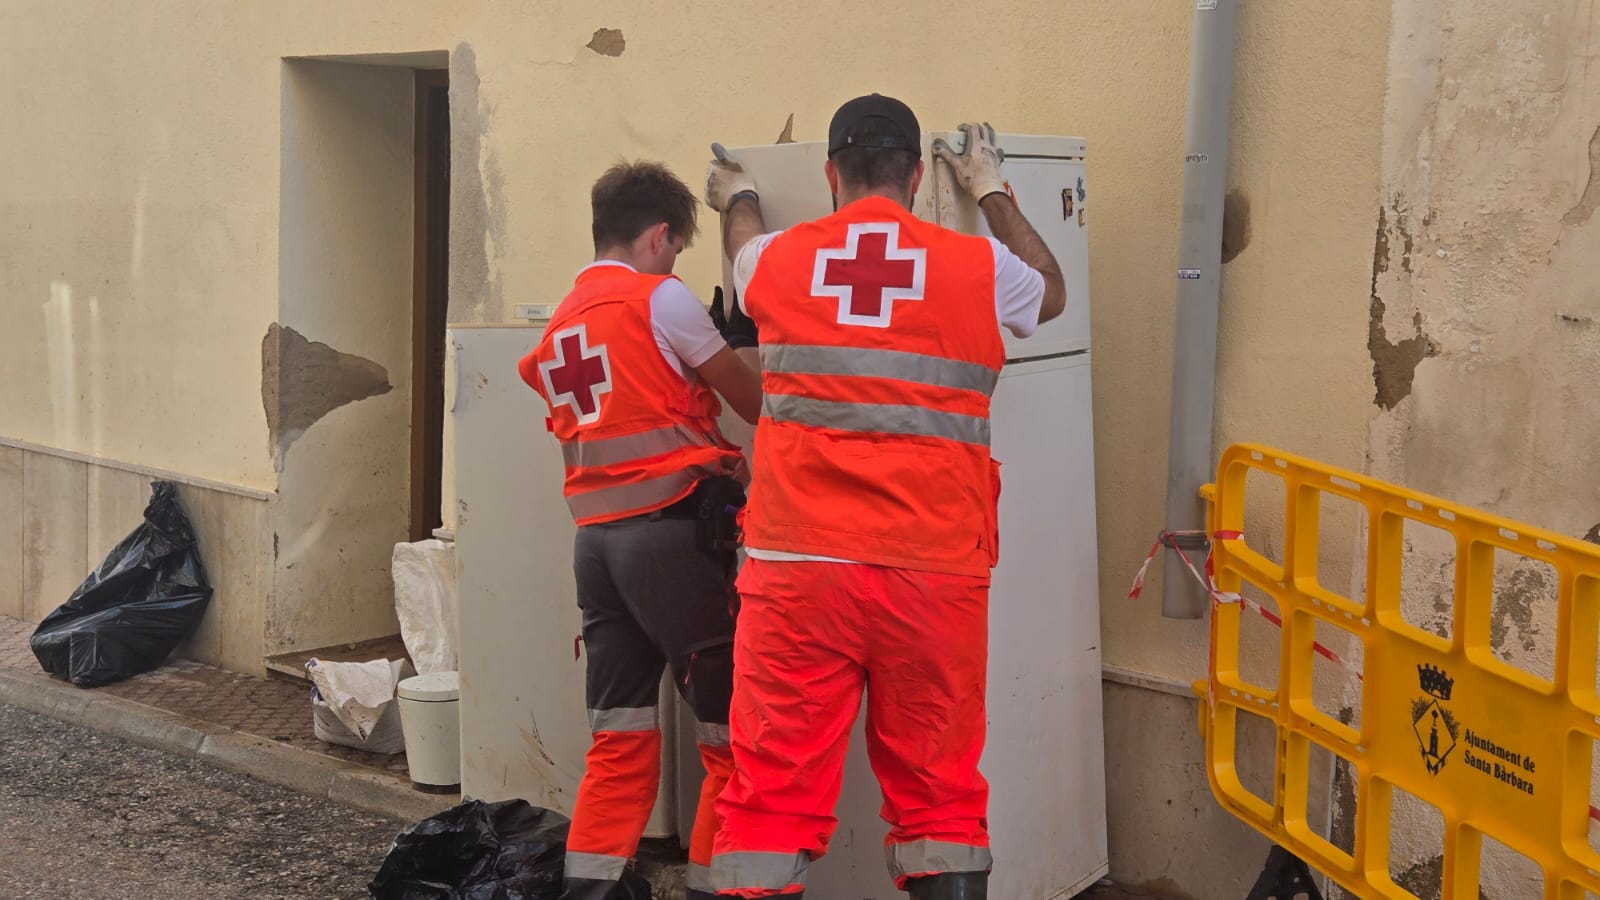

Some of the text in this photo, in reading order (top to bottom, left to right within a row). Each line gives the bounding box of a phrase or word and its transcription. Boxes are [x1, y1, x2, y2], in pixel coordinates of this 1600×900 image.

[1464, 728, 1536, 773] Ajuntament de
[1464, 750, 1534, 795] Santa Bàrbara
